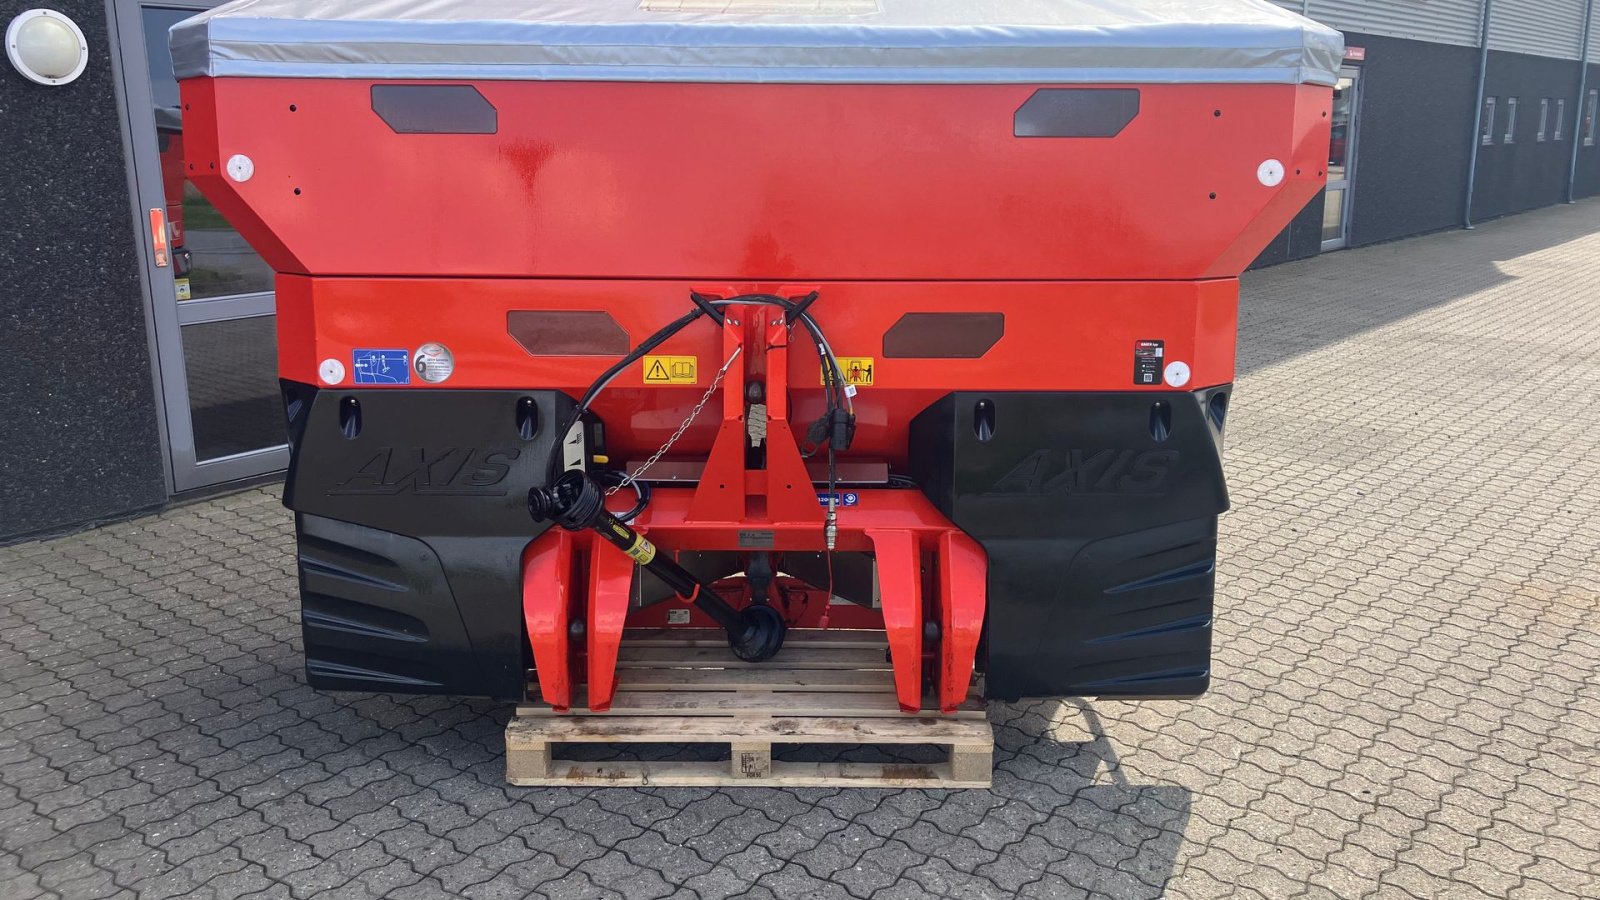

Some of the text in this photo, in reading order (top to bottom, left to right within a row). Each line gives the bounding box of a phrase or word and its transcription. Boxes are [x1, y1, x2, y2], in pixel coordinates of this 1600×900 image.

[415, 354, 427, 373] 6
[335, 447, 522, 488] AXIS
[992, 449, 1180, 490] AXIS
